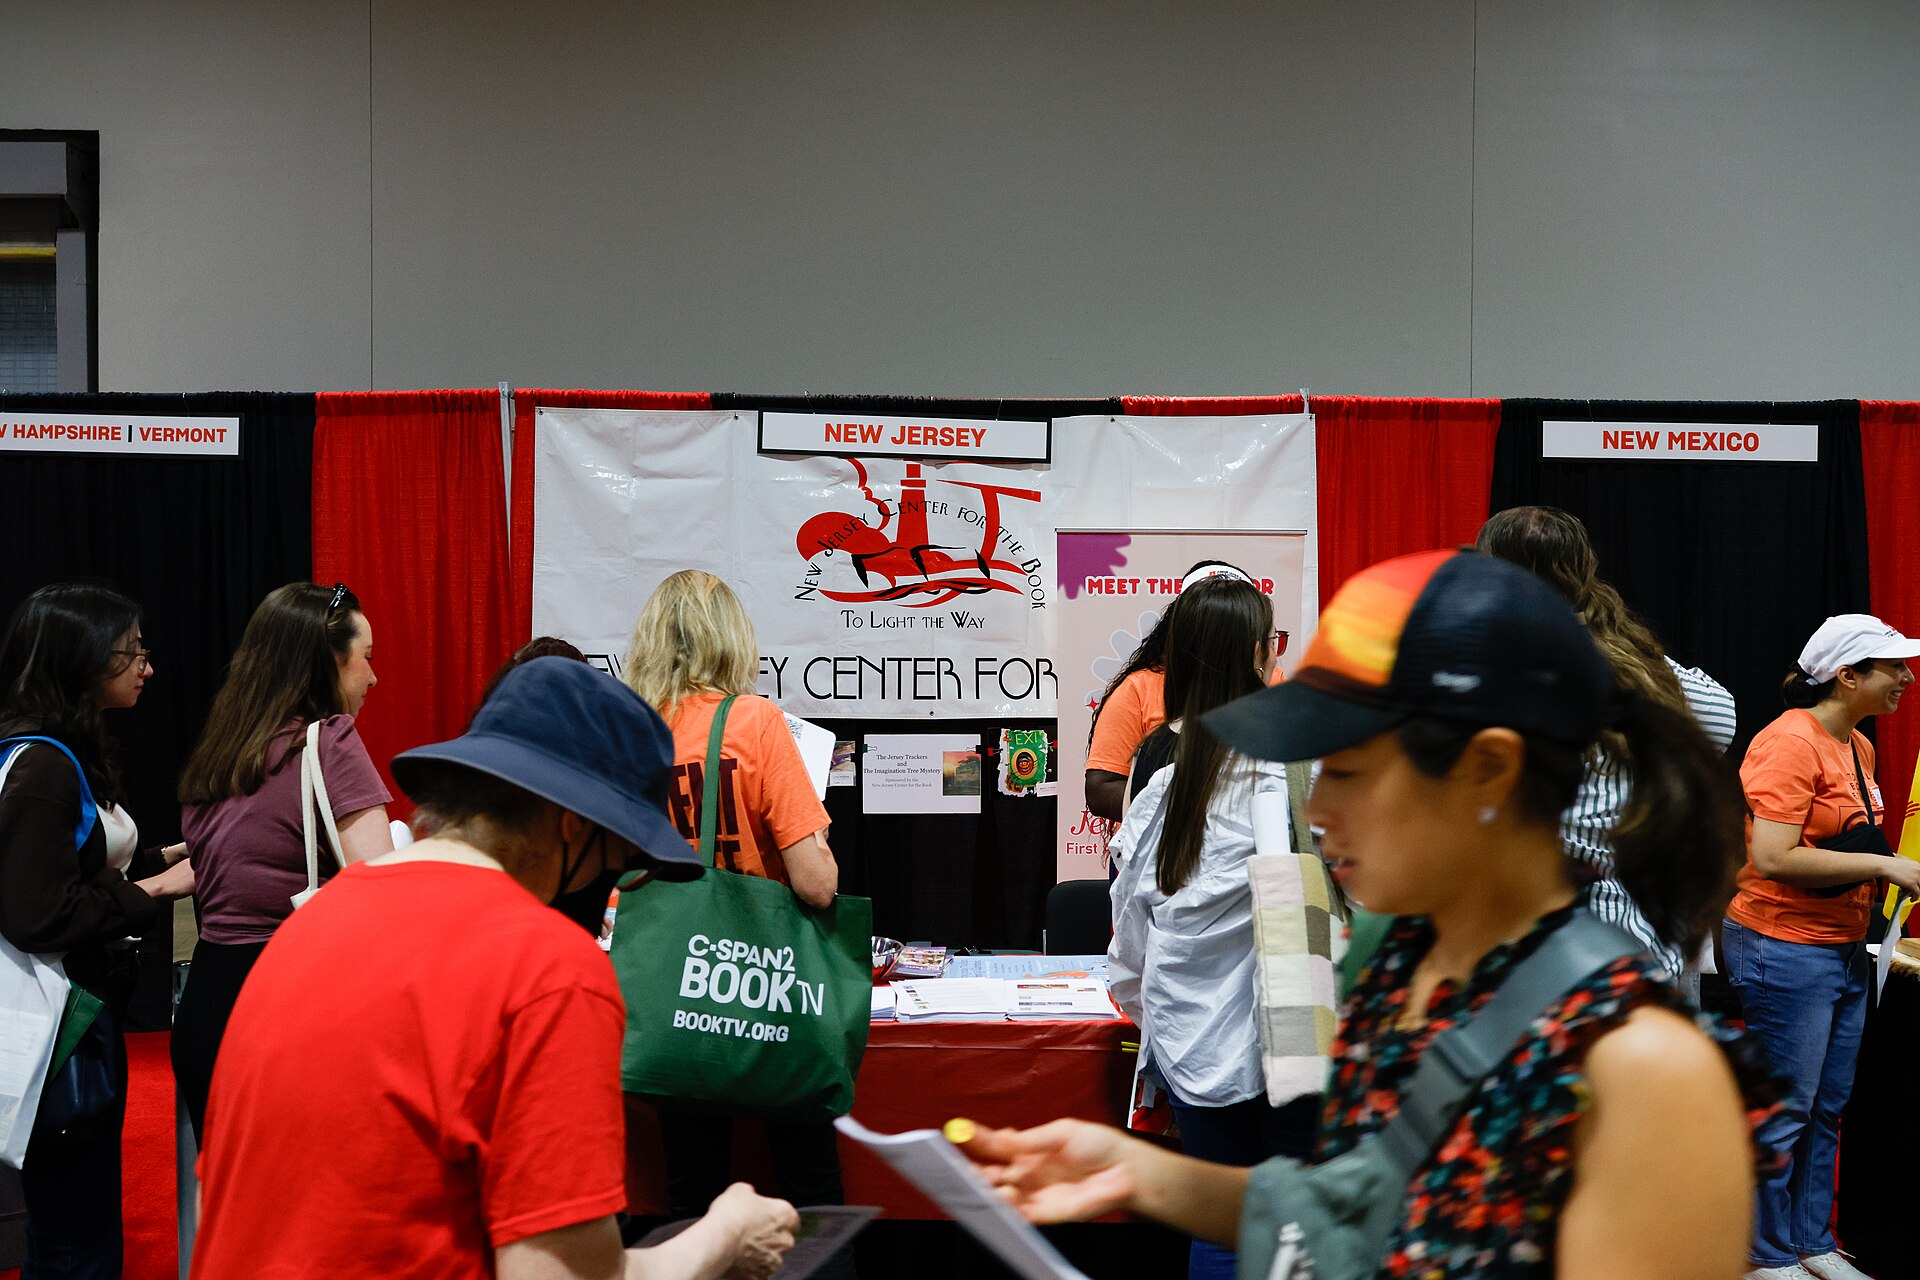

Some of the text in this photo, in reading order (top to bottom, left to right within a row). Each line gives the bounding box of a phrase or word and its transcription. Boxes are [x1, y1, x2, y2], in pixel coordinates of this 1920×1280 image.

[13, 423, 122, 441] HAMPSHIRE
[139, 426, 227, 443] VERMONT
[824, 422, 987, 448] NEW JERSEY
[1603, 430, 1760, 452] NEW MEXICO
[1087, 578, 1183, 595] MEET THE
[803, 655, 962, 700] CENTER
[975, 657, 1059, 700] FOR
[1066, 842, 1098, 855] First
[679, 956, 796, 1013] BOOK
[672, 1009, 789, 1042] BOOKTV.ORG
